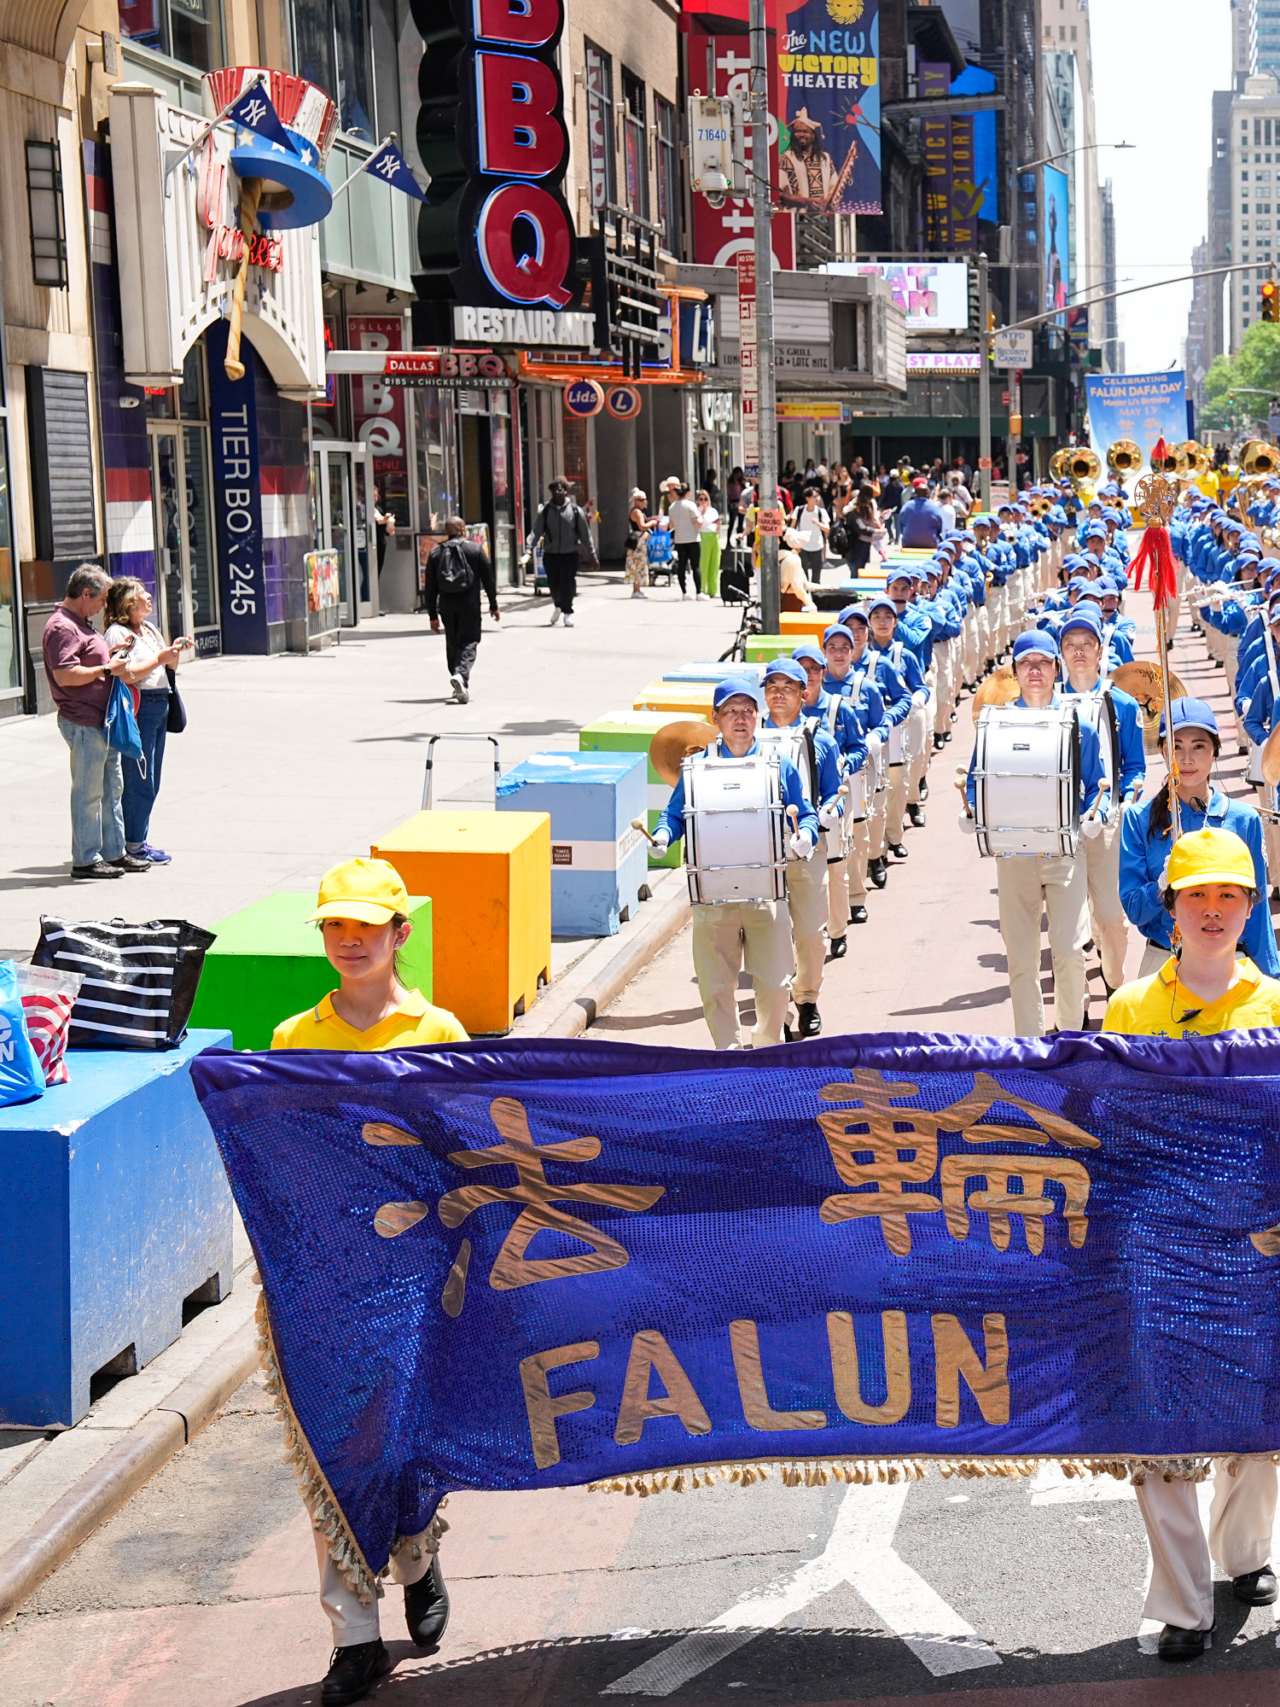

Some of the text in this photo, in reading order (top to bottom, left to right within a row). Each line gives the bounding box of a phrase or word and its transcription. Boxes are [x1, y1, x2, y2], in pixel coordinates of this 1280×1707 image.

[782, 30, 866, 54] The NEW
[782, 74, 859, 88] THEATER
[455, 306, 597, 347] RESTAURANT
[1002, 331, 1026, 340] NYPD
[389, 354, 504, 377] DALLAS BBQ
[934, 355, 982, 366] PLAY!
[384, 378, 510, 388] RIBS CHICKEN STEAKS
[1102, 375, 1168, 385] CELEBRATING
[1090, 382, 1182, 397] FALUN DAFA DAY
[568, 390, 597, 404] Lids
[1119, 408, 1142, 417] MAY
[220, 404, 258, 616] TIER BOX 245
[519, 1309, 1011, 1470] FALUN
